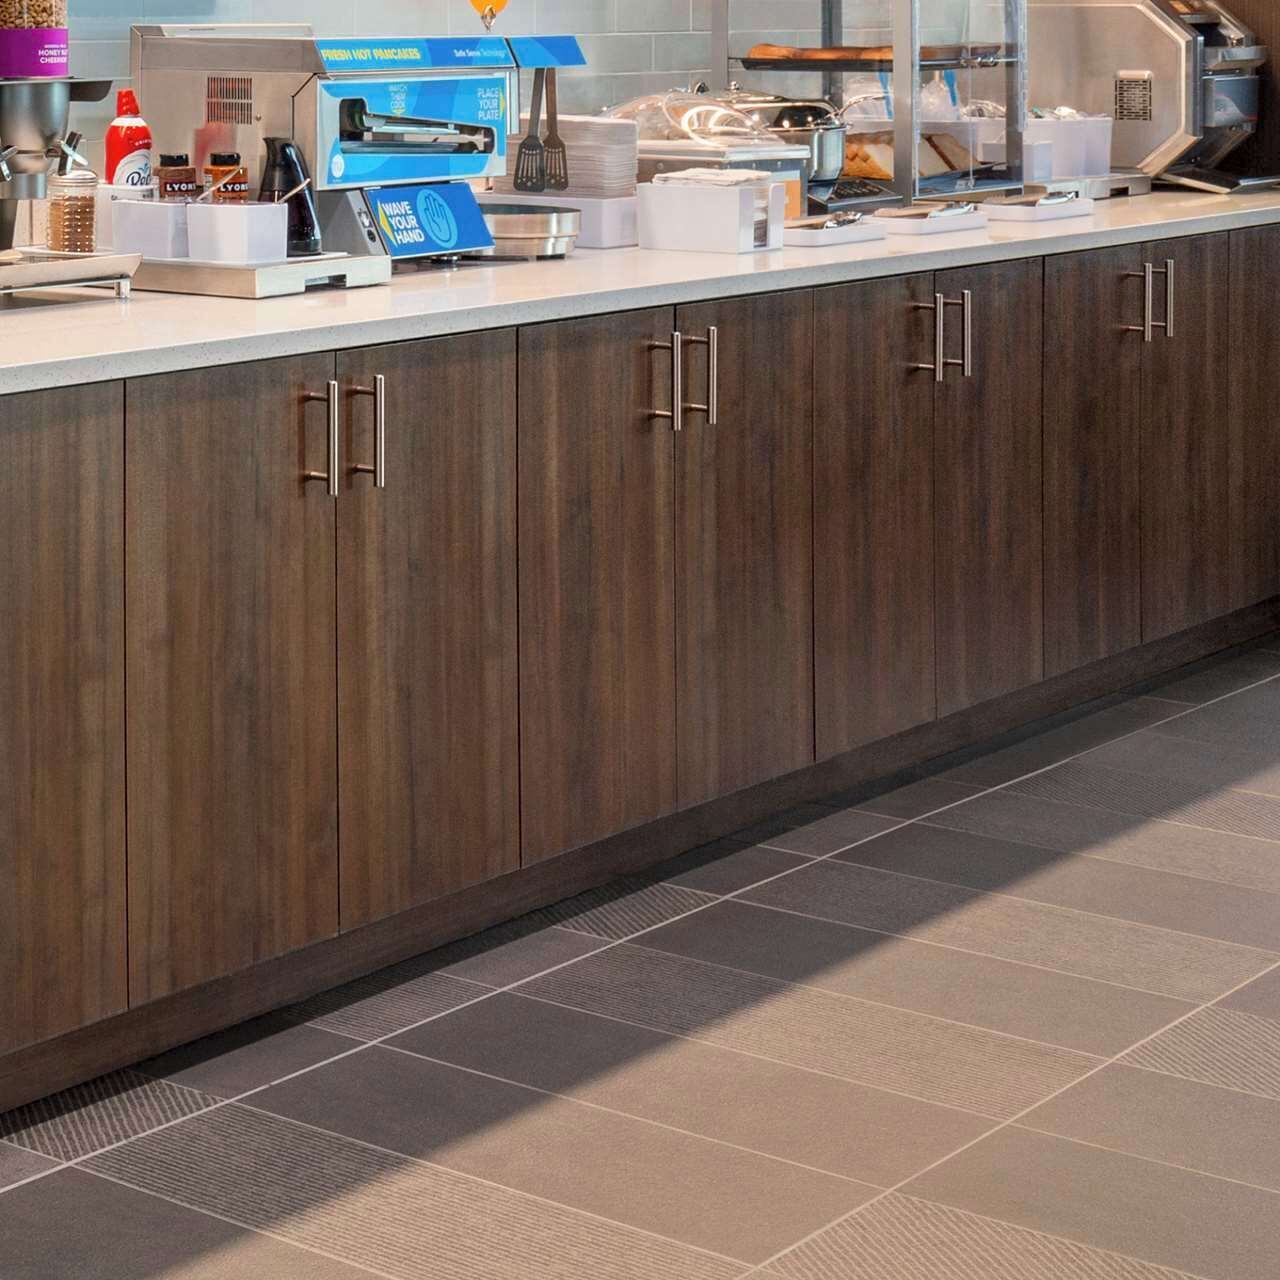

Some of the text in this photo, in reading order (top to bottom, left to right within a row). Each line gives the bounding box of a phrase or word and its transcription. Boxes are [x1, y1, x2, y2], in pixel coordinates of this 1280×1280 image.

[321, 49, 352, 61] FRESH
[353, 49, 371, 60] HOT
[477, 87, 499, 98] PLACE
[479, 99, 498, 109] YOUR
[478, 110, 500, 120] PLATE
[381, 200, 413, 216] WAVE
[389, 214, 419, 230] YOUR
[395, 230, 425, 245] HAND
